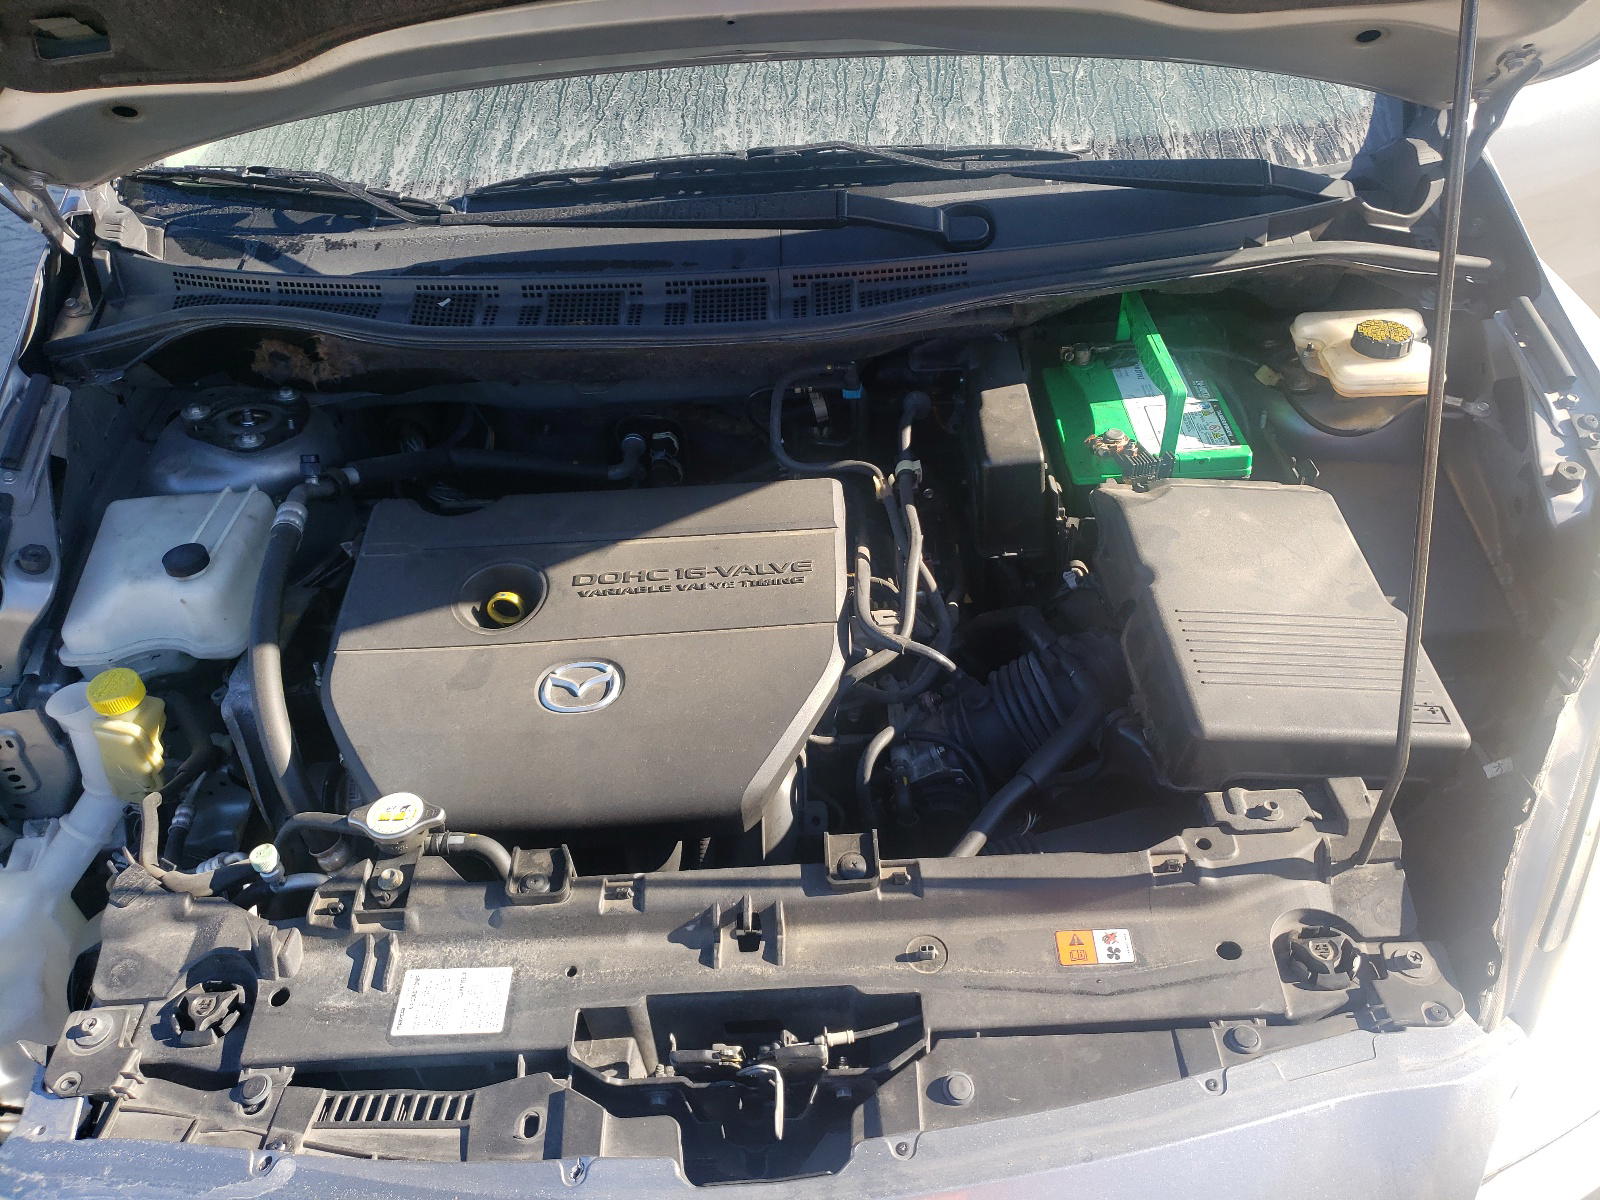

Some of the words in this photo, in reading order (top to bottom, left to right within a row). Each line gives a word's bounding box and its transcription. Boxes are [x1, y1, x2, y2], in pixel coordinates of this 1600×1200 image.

[571, 568, 670, 587] DOHC
[674, 560, 813, 580] 16-VALVE
[577, 584, 672, 598] VARIABLE
[676, 580, 735, 592] VALVE
[738, 576, 805, 588] TIMING
